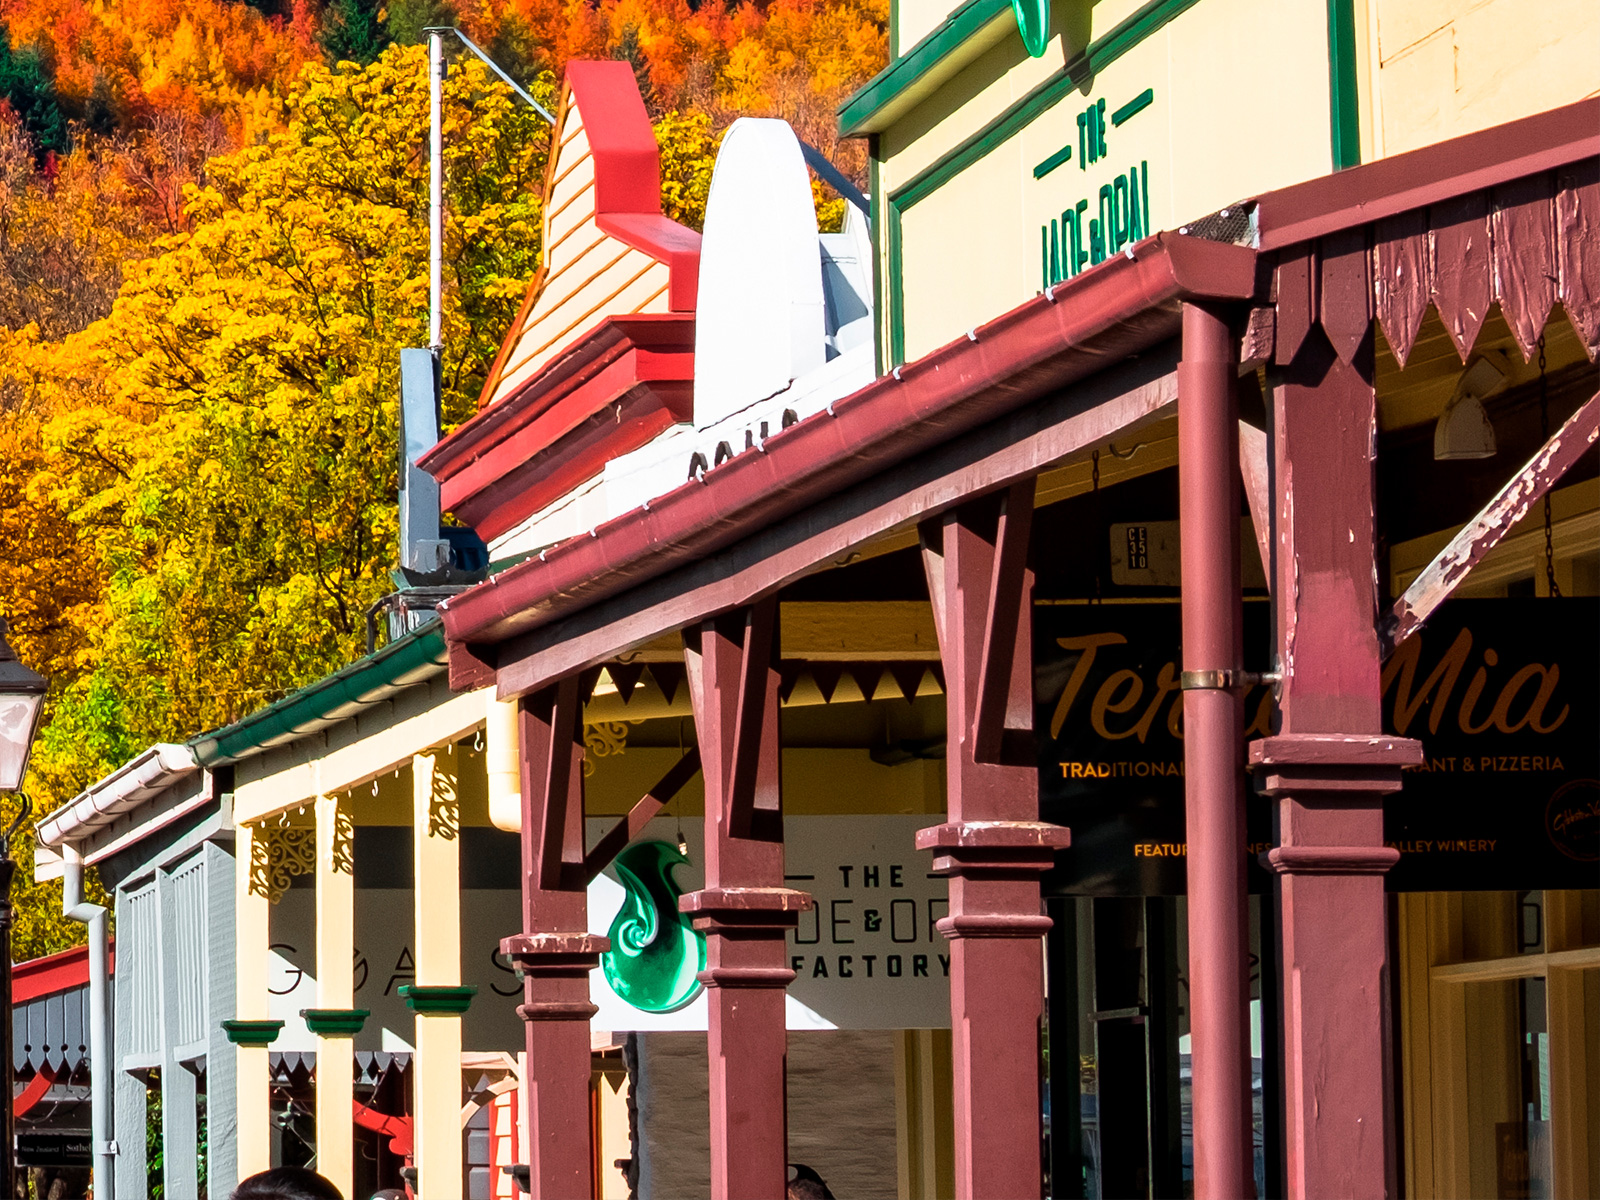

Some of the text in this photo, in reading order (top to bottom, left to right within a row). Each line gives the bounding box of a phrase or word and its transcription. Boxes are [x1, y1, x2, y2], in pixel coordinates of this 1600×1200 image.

[1076, 97, 1107, 172] THE
[1380, 626, 1570, 736] Mia
[1462, 757, 1475, 772] &
[1480, 756, 1565, 772] PIZZERIA
[1436, 839, 1498, 852] WINERY
[838, 865, 904, 888] THE
[864, 909, 882, 932] &
[791, 954, 950, 979] FACTORY
